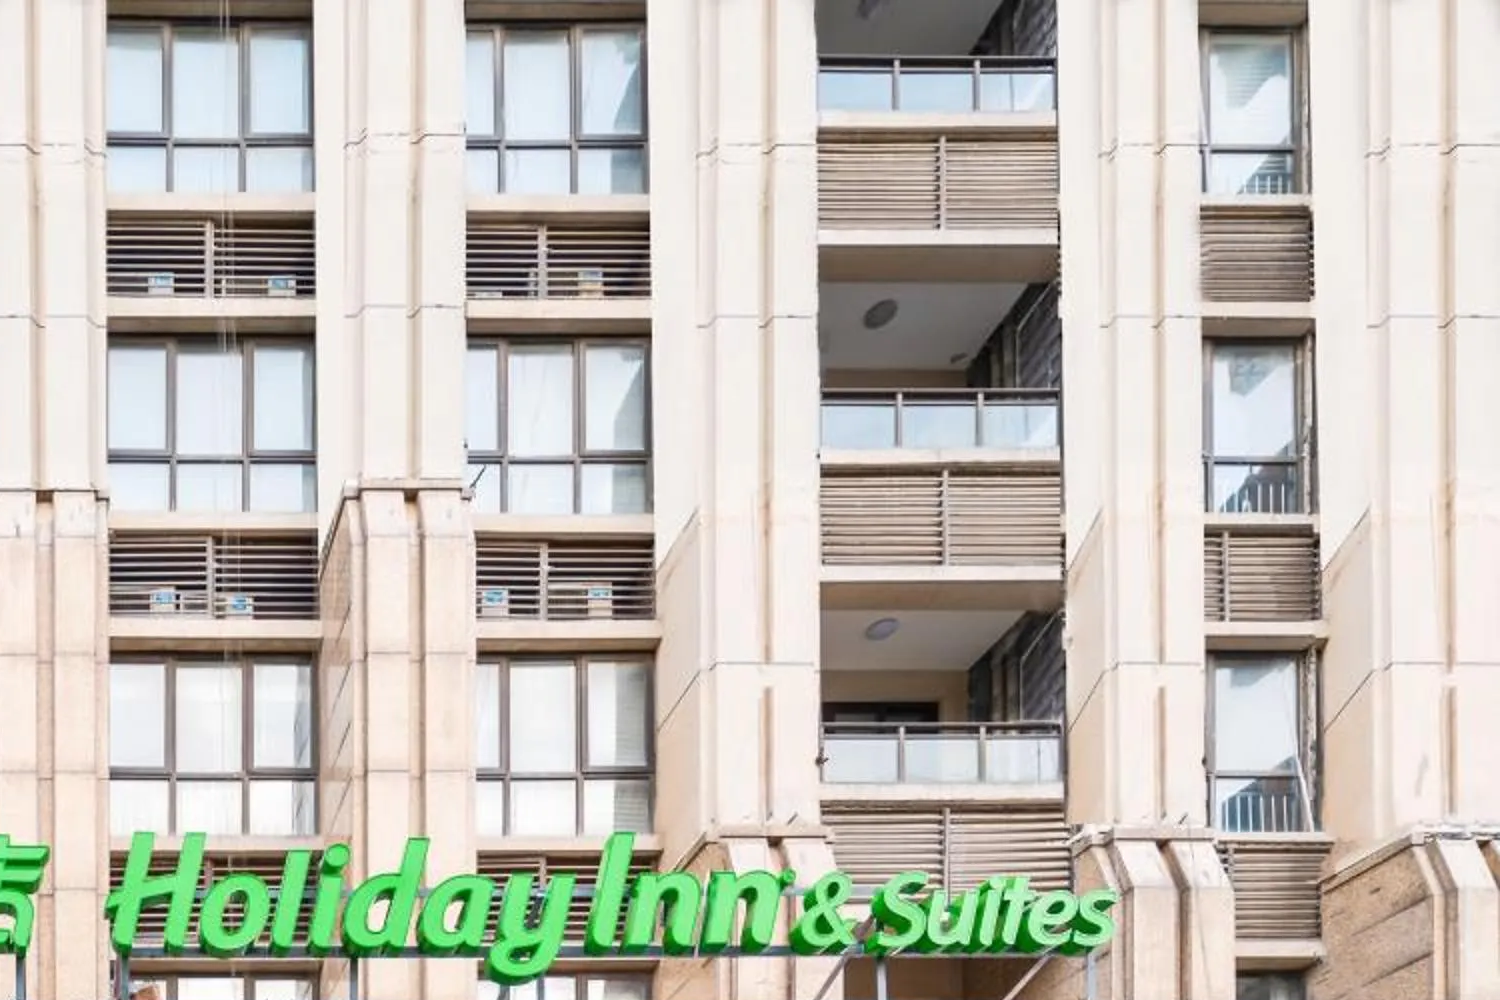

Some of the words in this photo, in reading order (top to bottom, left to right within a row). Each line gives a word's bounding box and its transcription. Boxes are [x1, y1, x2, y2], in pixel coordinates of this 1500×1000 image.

[104, 831, 576, 985] Holiday
[584, 832, 792, 955] Inn
[788, 871, 857, 956] &
[866, 870, 1117, 956] Suites
